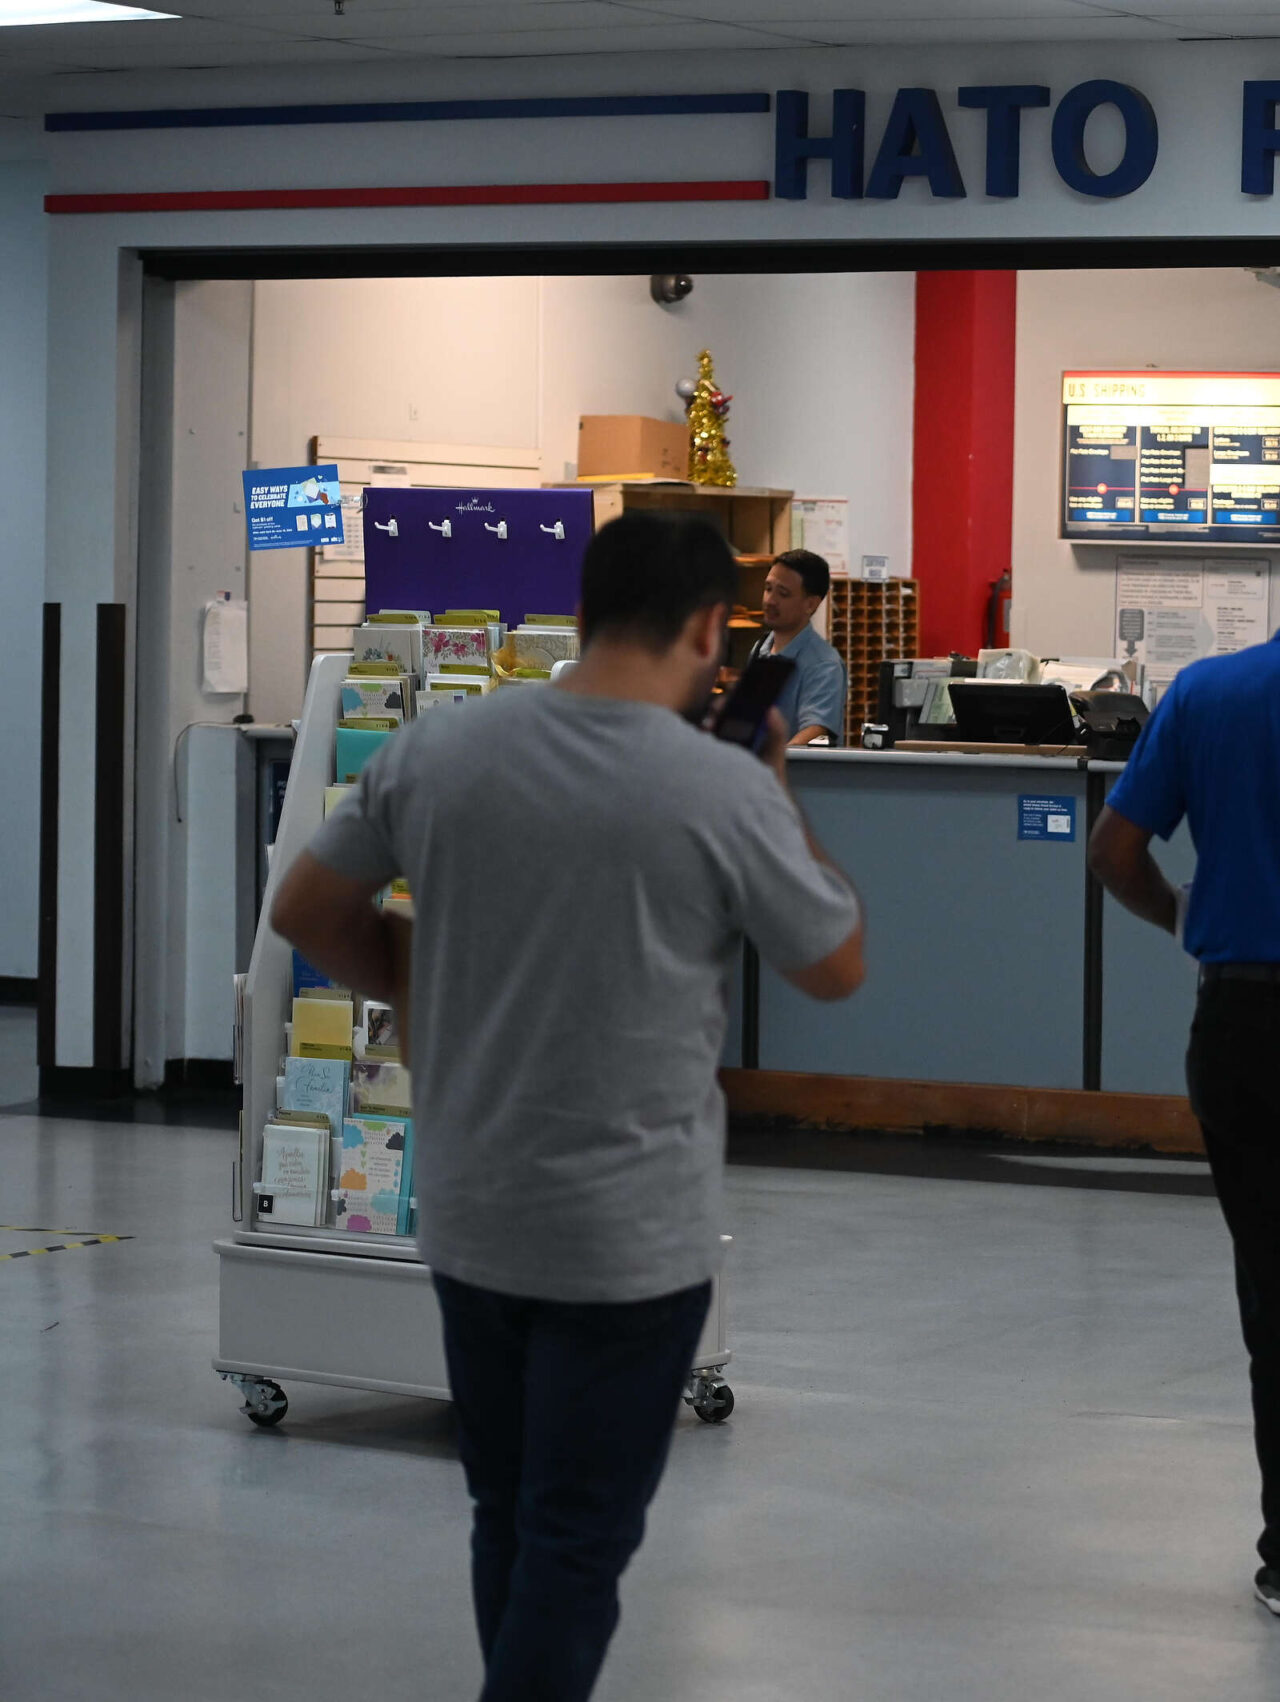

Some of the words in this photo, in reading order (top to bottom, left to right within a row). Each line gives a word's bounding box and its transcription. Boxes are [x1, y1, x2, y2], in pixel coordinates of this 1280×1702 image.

[775, 79, 1160, 199] HATO
[1094, 383, 1146, 398] SHIPPING
[252, 486, 269, 494] EASY
[270, 485, 288, 493] WAYS
[258, 493, 286, 501] CELEBRATE
[250, 499, 286, 509] EVERYONE
[455, 500, 496, 516] Hallmark
